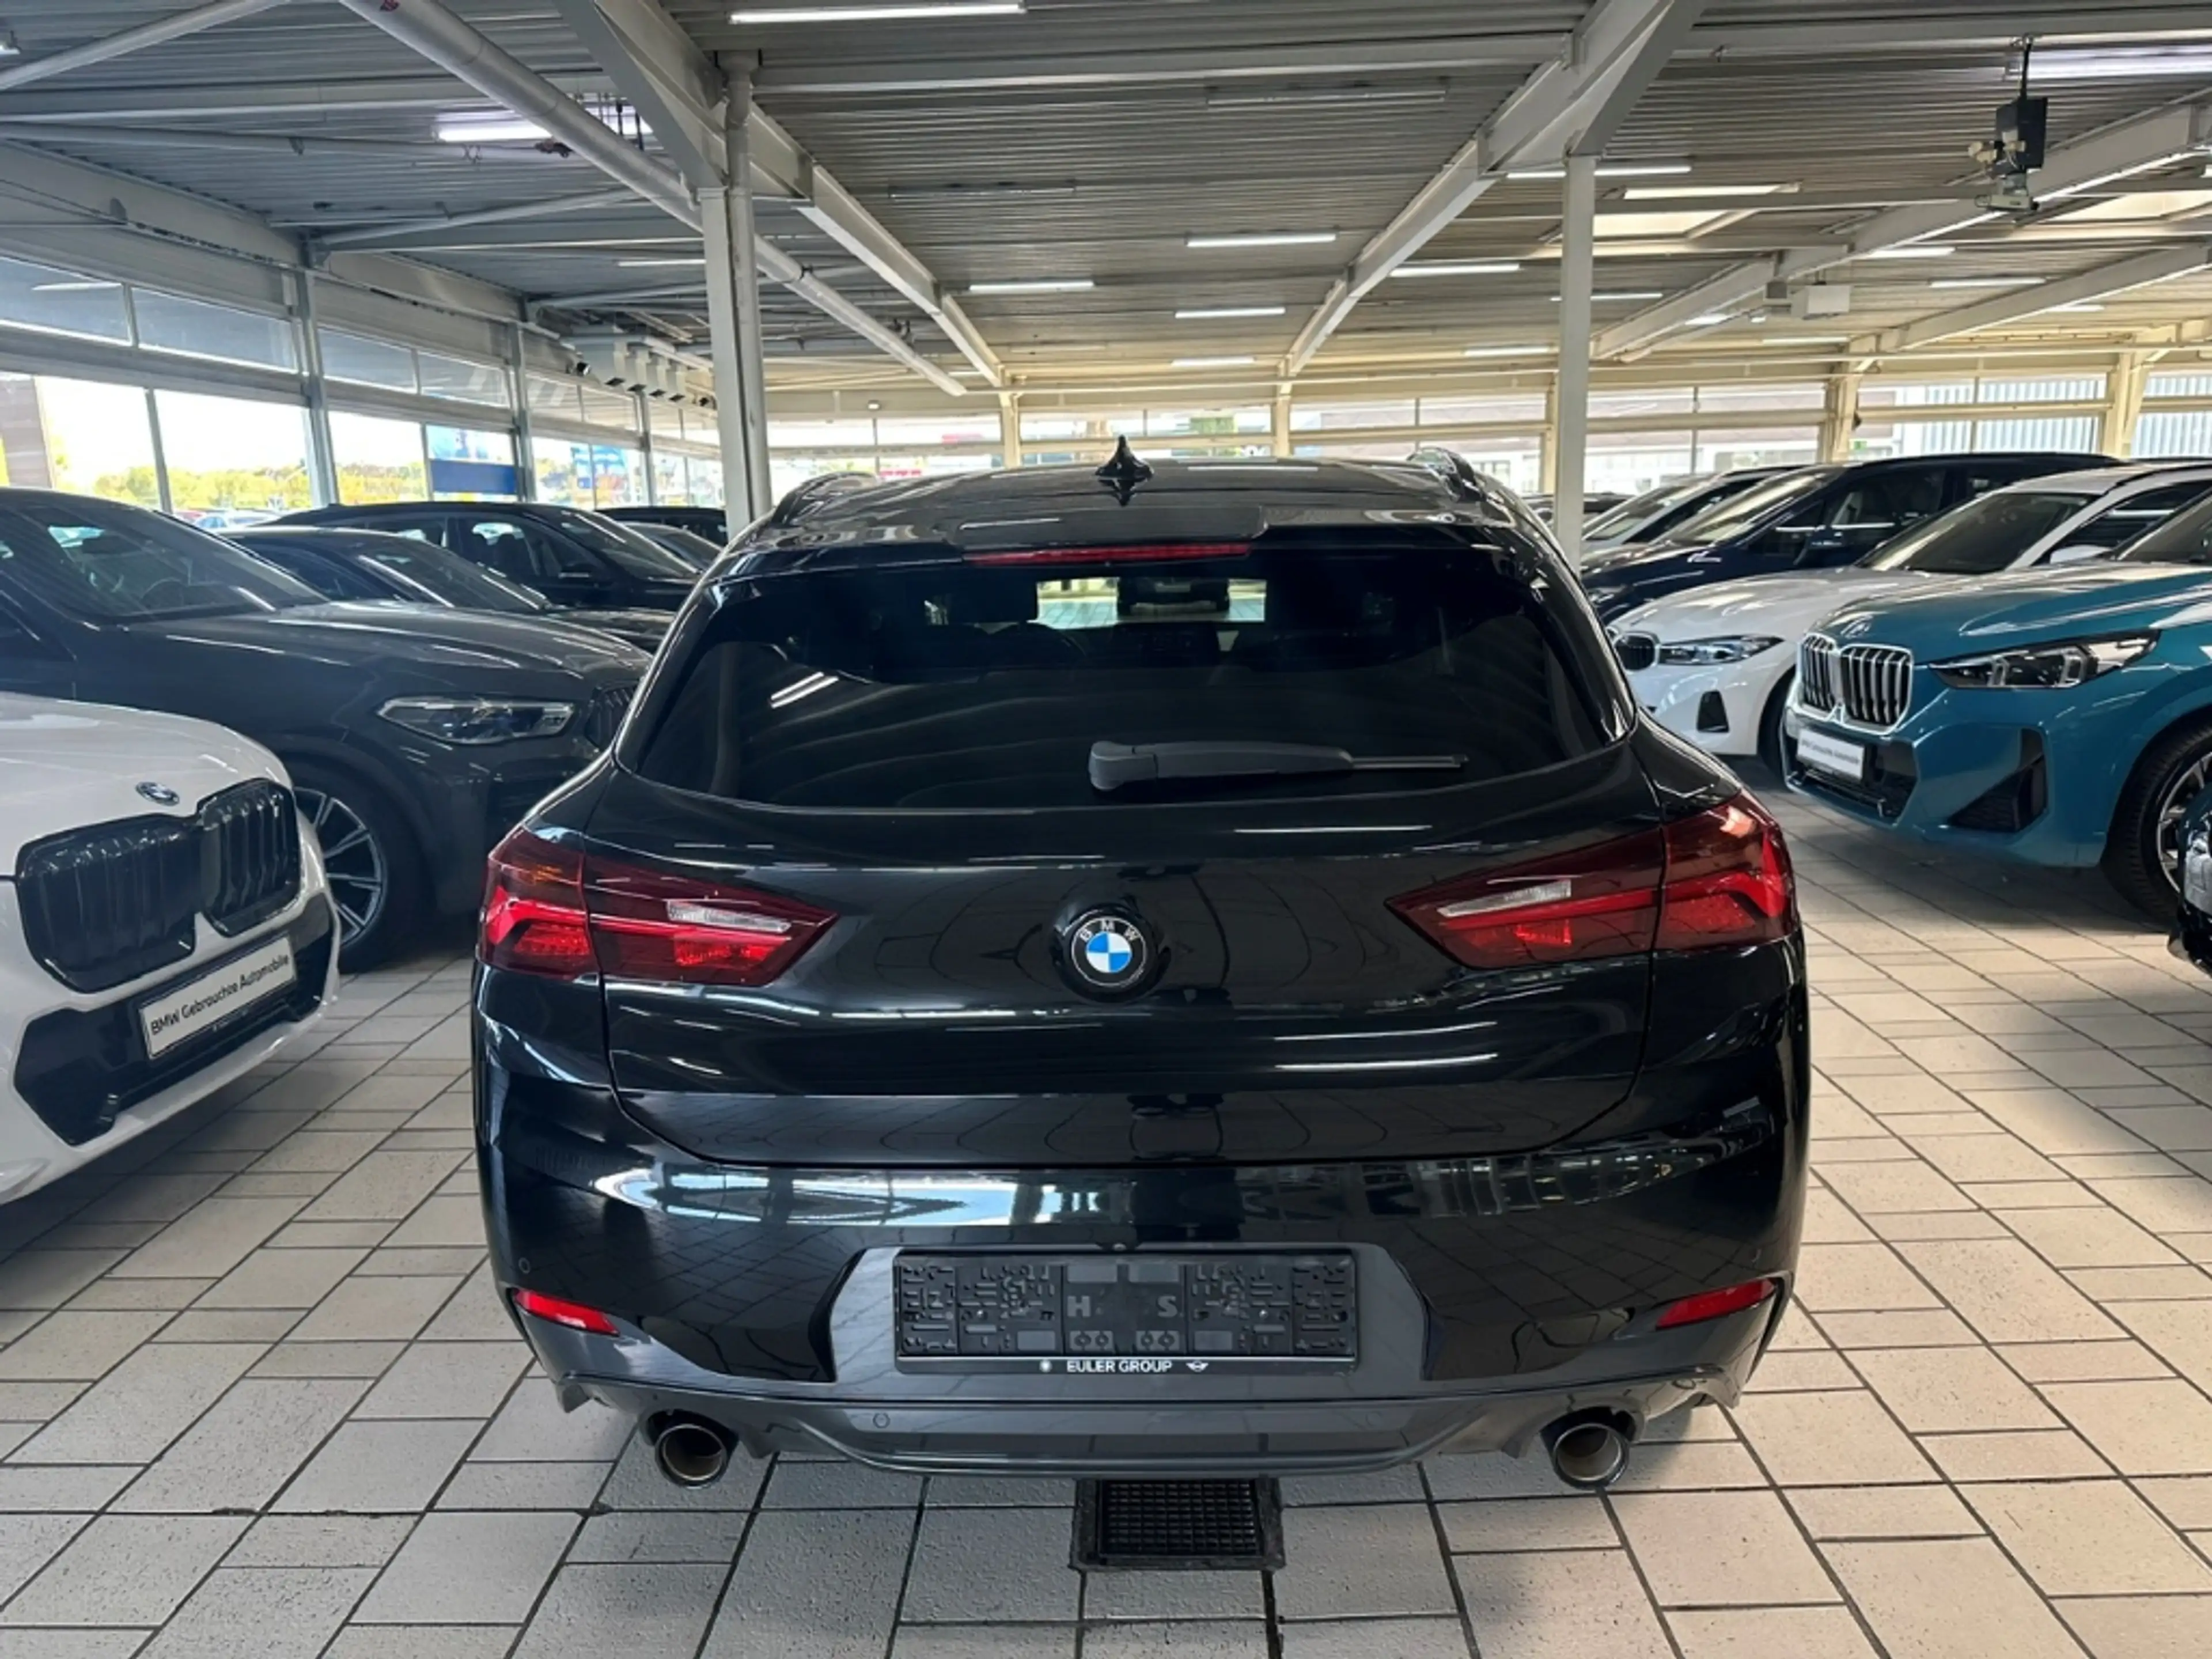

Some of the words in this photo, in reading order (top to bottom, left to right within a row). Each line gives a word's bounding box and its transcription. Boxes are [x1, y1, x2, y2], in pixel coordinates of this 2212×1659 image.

[1079, 919, 1140, 942] BMW
[150, 1009, 180, 1035] BMW
[1067, 1296, 1091, 1317] H
[1157, 1296, 1178, 1317] S
[1067, 1360, 1116, 1373] EULER
[1118, 1360, 1172, 1373] GROUP
